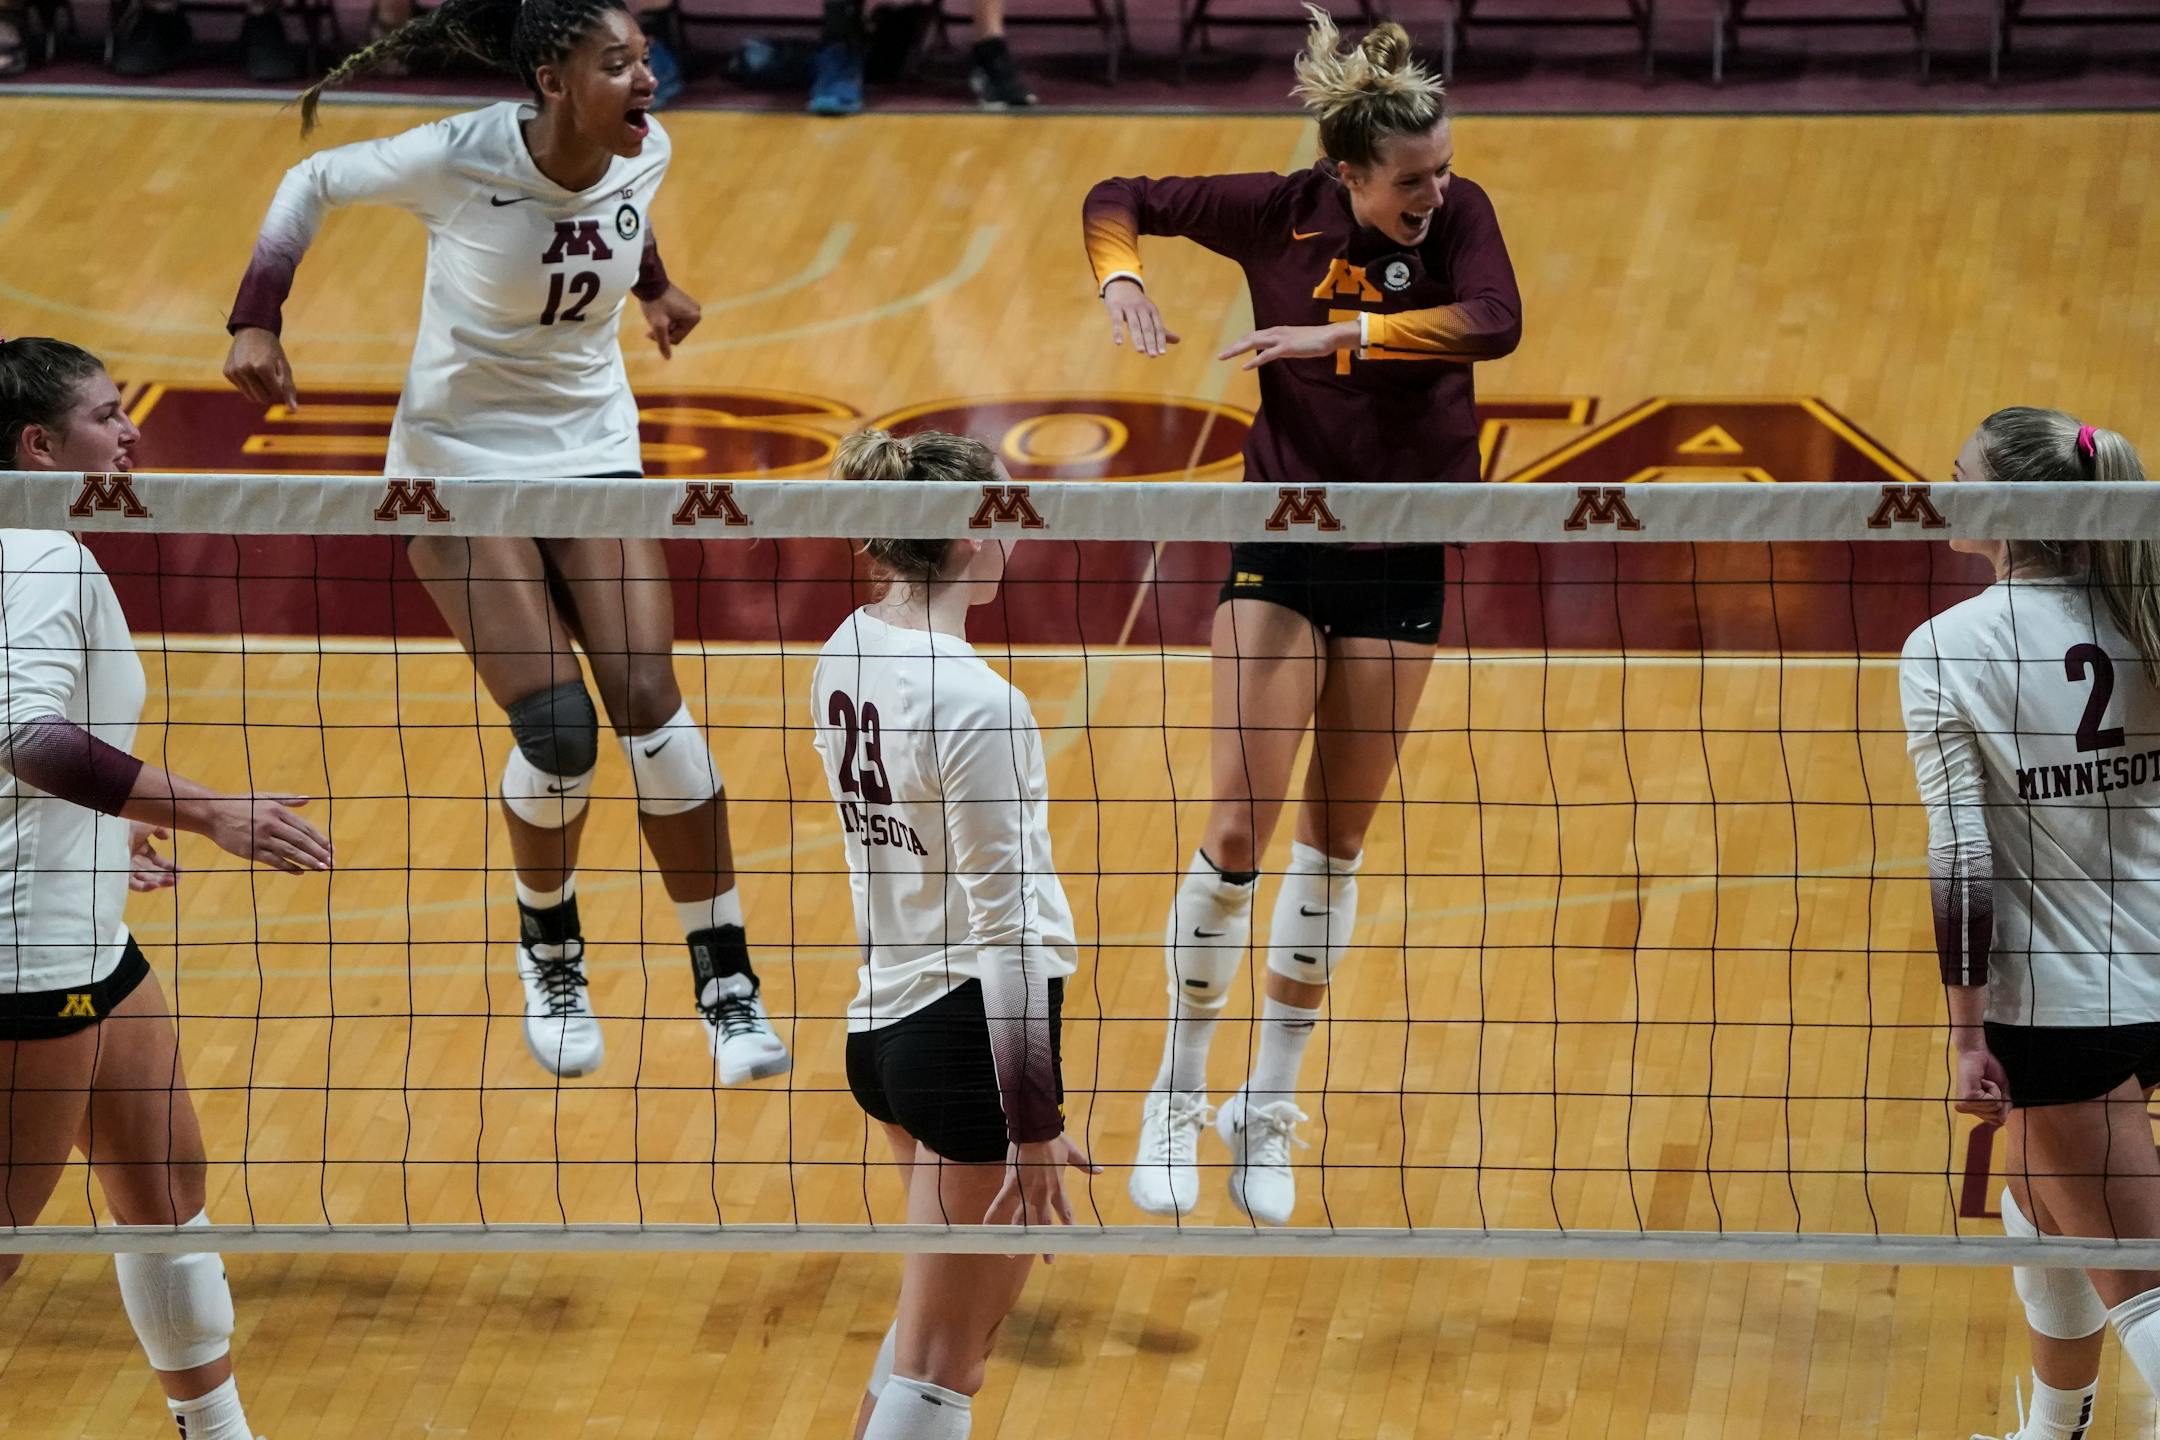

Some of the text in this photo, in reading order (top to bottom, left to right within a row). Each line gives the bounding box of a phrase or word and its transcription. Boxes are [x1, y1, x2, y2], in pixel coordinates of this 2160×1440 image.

[542, 220, 613, 264] M
[540, 271, 600, 326] 12
[1312, 258, 1383, 302] M
[70, 473, 148, 517] M
[374, 479, 450, 521] M
[672, 482, 748, 526] M
[969, 485, 1044, 528] M
[1265, 487, 1340, 531] M
[1564, 487, 1640, 531] M
[1868, 485, 1945, 529] M
[2065, 643, 2125, 752] 2
[829, 690, 892, 805] 23
